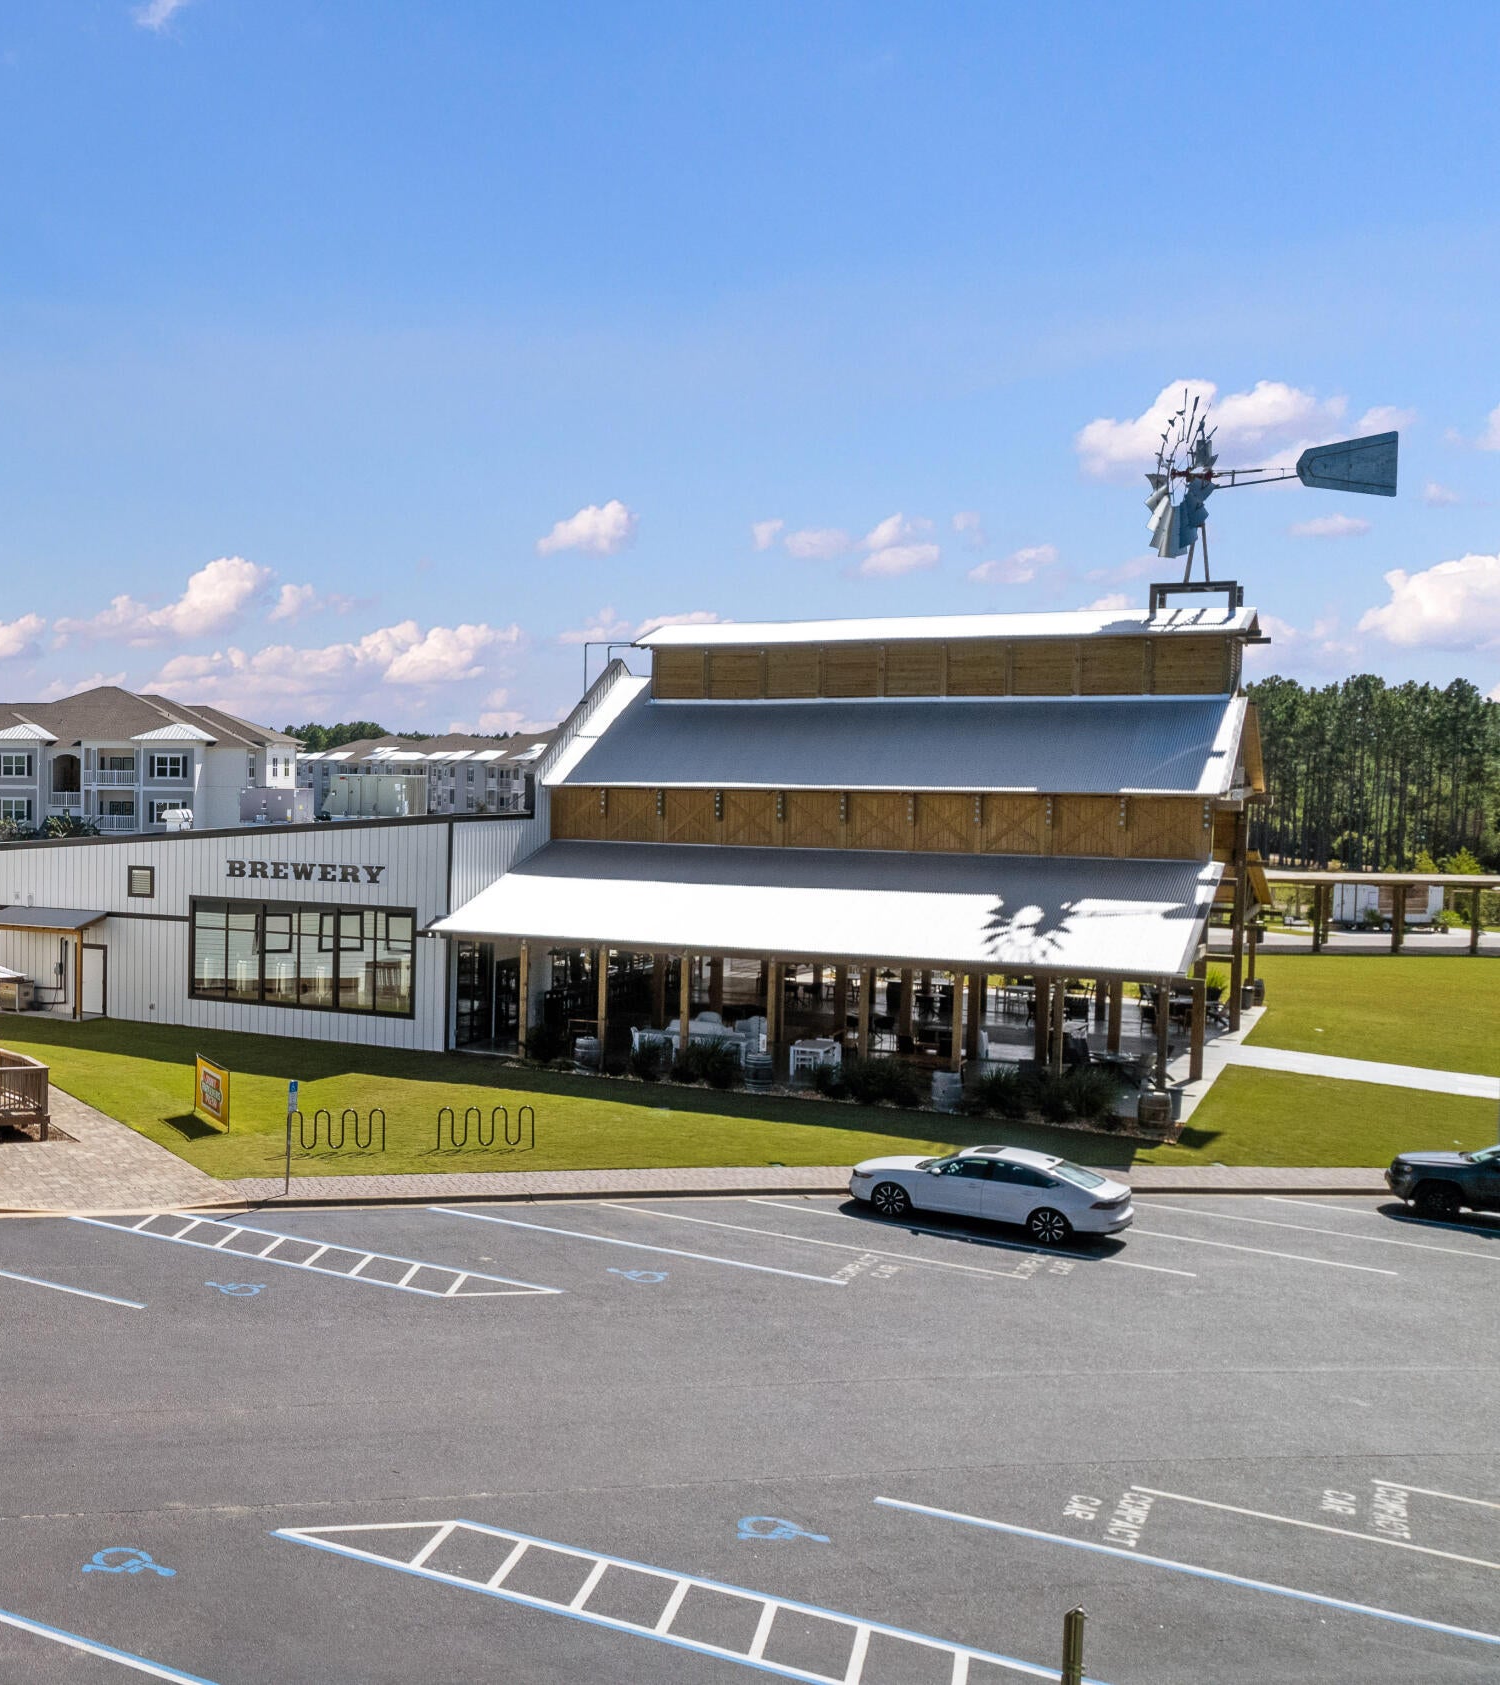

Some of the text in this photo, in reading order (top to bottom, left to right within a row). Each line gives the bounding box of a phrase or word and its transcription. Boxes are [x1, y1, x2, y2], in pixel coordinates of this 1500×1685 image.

[226, 860, 385, 884] BREWERY
[1062, 1492, 1155, 1548] COMPACT CAR
[1320, 1486, 1412, 1540] COMPACT CAR
